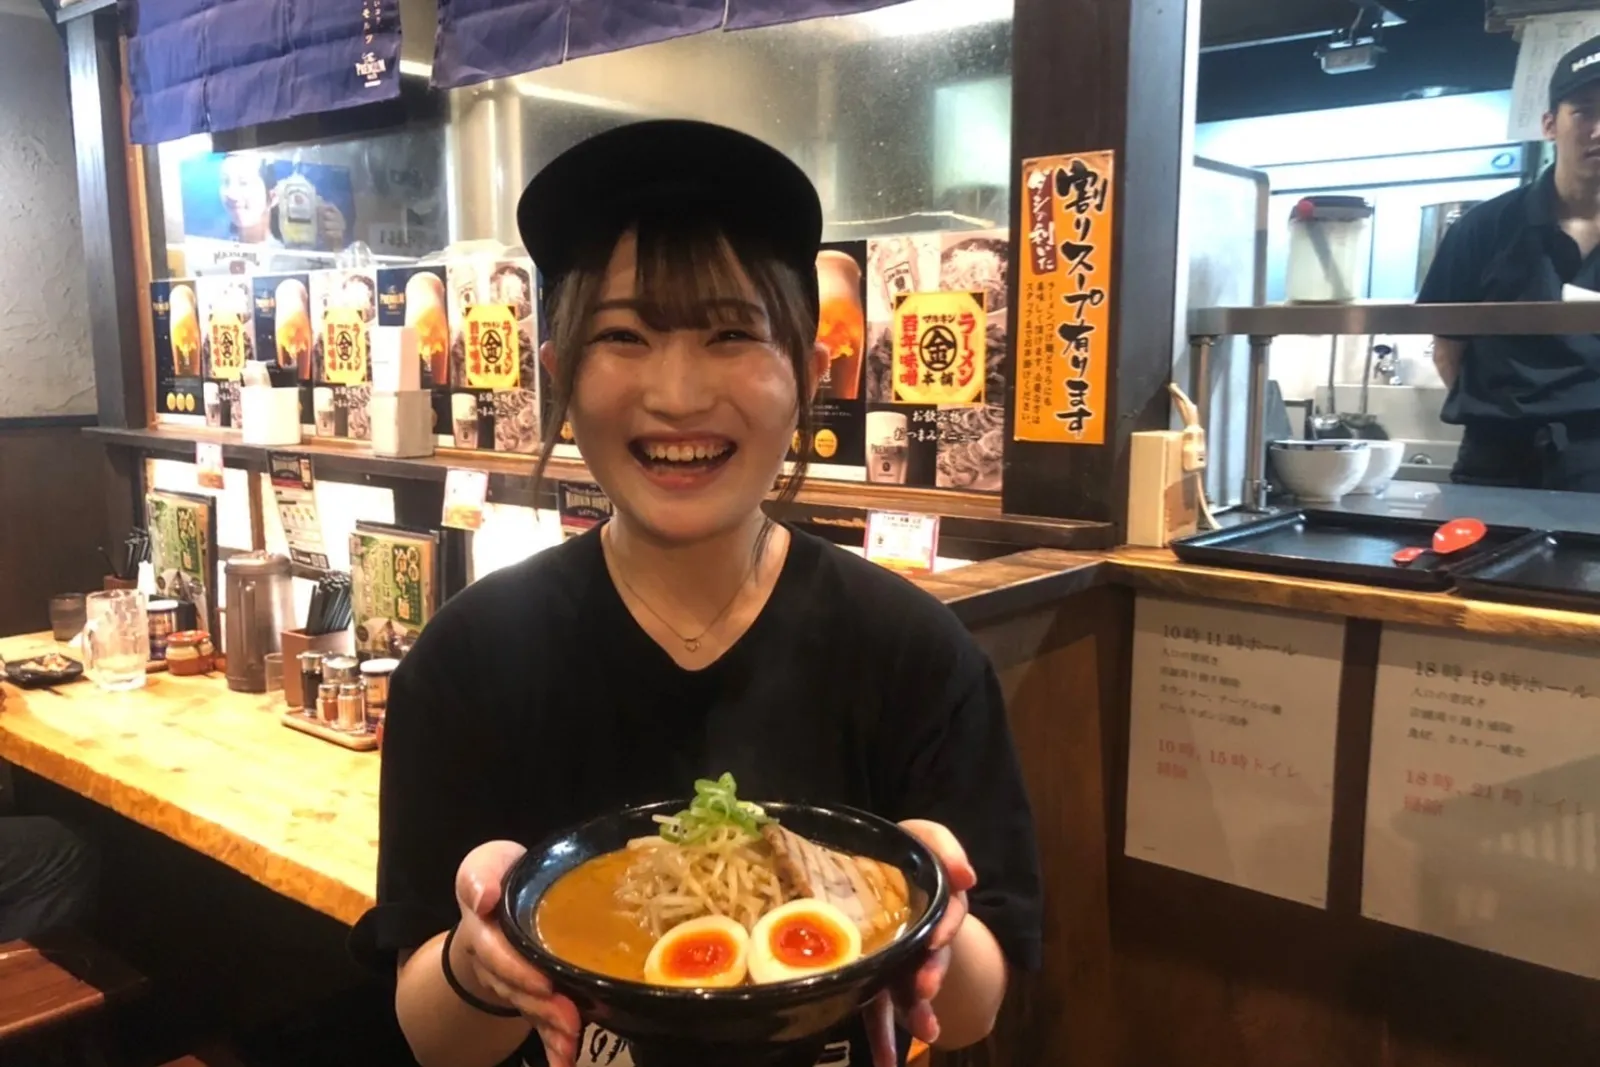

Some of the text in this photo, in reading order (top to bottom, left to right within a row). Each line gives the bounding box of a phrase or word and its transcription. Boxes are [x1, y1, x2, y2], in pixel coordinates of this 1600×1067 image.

[1028, 168, 1055, 270] ダシの利いた
[922, 314, 956, 324] マルキン
[1056, 159, 1108, 432] 割りスープ有ります
[899, 314, 920, 387] 百年味噌
[958, 312, 976, 387] ラーメン
